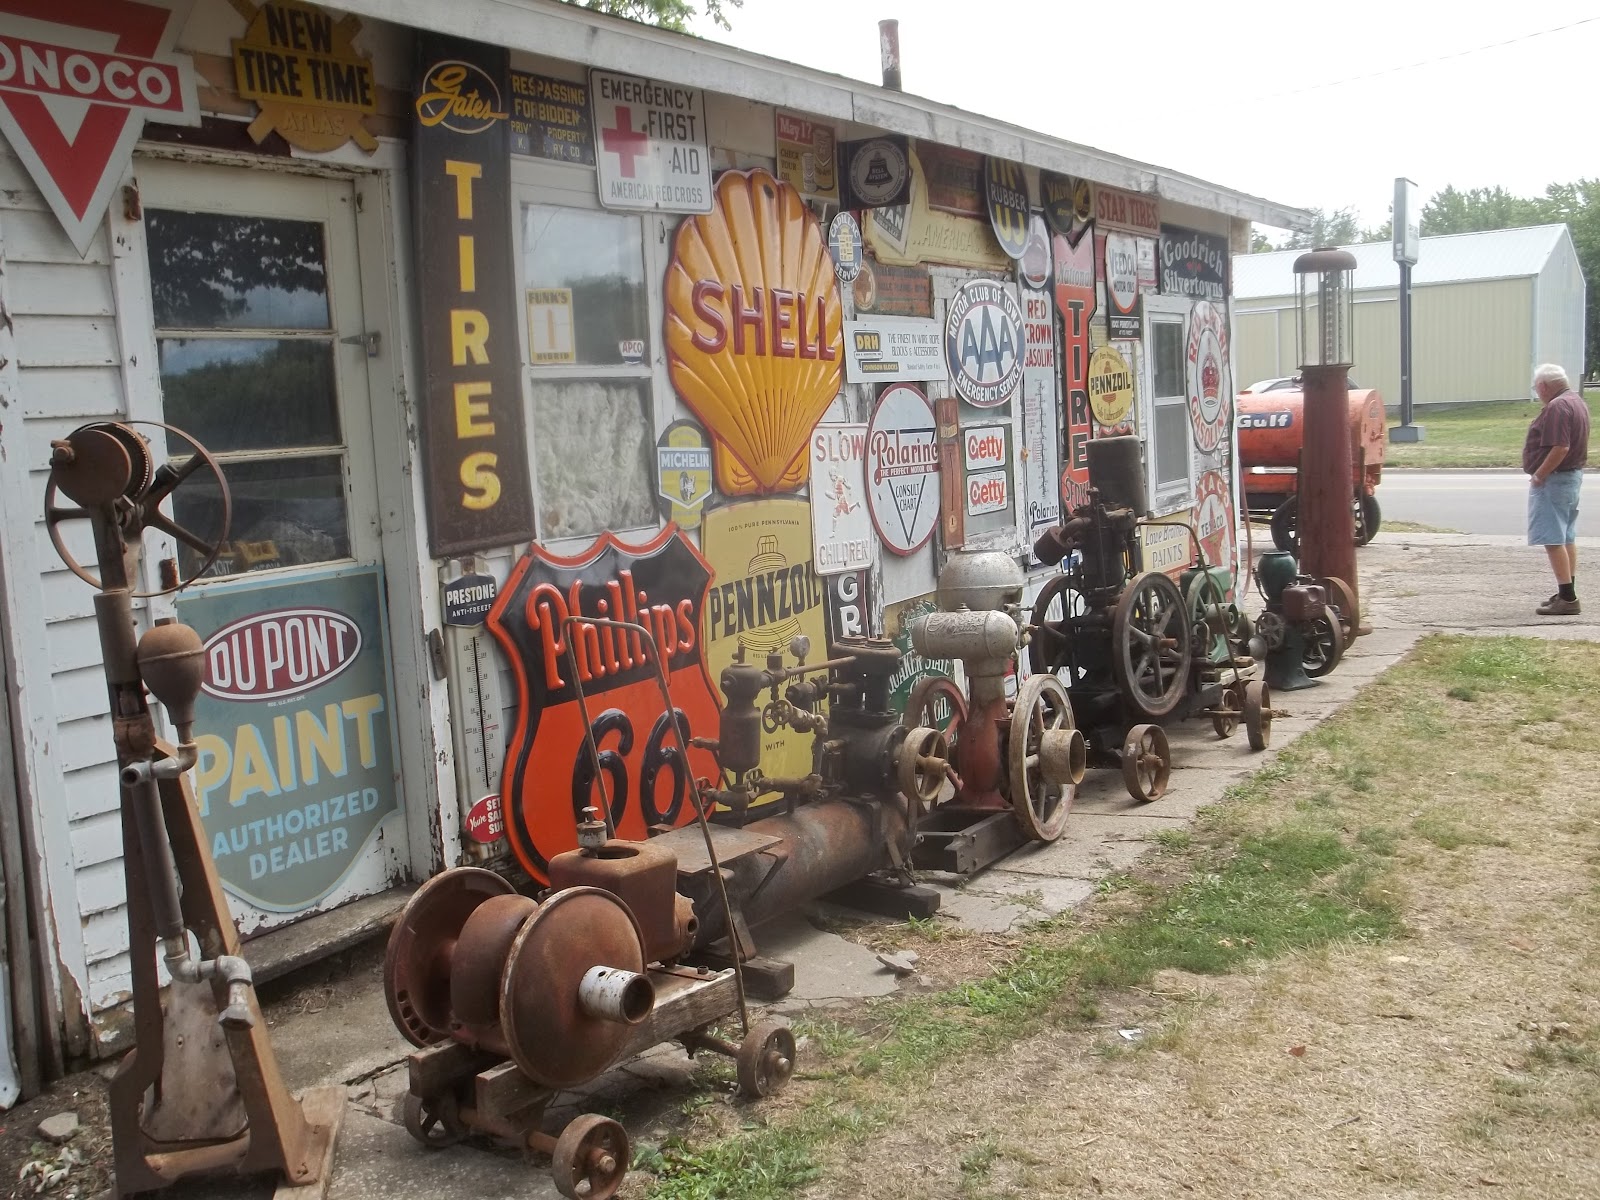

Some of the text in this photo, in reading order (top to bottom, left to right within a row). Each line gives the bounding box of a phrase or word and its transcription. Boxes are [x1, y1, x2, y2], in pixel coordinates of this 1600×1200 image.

[265, 3, 332, 54] NEW
[239, 48, 373, 106] TIRE TIME
[511, 74, 586, 106] RESPASSING
[415, 66, 509, 126] Gates
[601, 78, 694, 111] EMERGENCY
[283, 111, 346, 136] ATLAS
[514, 98, 580, 127] FORBIDDEN
[648, 111, 696, 143] FIRST
[672, 147, 700, 175] AID
[611, 181, 703, 204] AMERICAN RED CROSS
[990, 184, 1027, 213] RUBBER
[1097, 191, 1127, 223] STAR
[1130, 197, 1158, 231] TIRES
[830, 213, 860, 238] CADILLAC
[1109, 247, 1137, 278] VEEDOL
[1164, 235, 1223, 278] Goodrich
[834, 264, 860, 281] SERVICE
[1058, 261, 1093, 286] National
[1164, 268, 1224, 298] Silvertowns
[528, 292, 568, 305] FUNK'S
[950, 297, 969, 338] MOTOR
[970, 285, 988, 301] CLUB
[992, 288, 1001, 301] OF
[1004, 298, 1022, 331] IOWA
[1027, 300, 1047, 319] RED
[691, 279, 836, 361] SHELL
[445, 160, 503, 510] TIRES
[622, 341, 643, 354] APCO
[856, 335, 879, 350] DRH
[961, 305, 1016, 383] AAA
[956, 359, 1022, 402] EMERGENCY SERVICE
[1067, 300, 1089, 471] TIRE
[1090, 371, 1131, 397] PENNZOIL
[1190, 395, 1229, 449] GASOLINE
[1237, 414, 1290, 428] Gulf
[660, 452, 709, 468] MICHELIN
[815, 434, 865, 462] SLOW
[968, 434, 1004, 462] Getty
[880, 465, 934, 477] THE PERFECT MOTOR OIL
[896, 483, 920, 498] CONSULT
[900, 497, 918, 512] CHART
[970, 480, 1004, 506] Getty
[729, 519, 800, 533] 100% PURE PENNSYLVANIA
[1030, 501, 1058, 529] Polarine
[1201, 514, 1224, 538] TEXACO
[1145, 526, 1162, 547] Lowe
[819, 538, 869, 566] CHILDREN
[1152, 543, 1183, 569] PAINTS
[446, 583, 495, 607] PRESTONE
[709, 560, 821, 641] PENNZOIL
[525, 569, 696, 689] Phillips
[210, 617, 348, 691] DU PONT
[933, 696, 951, 722] OIL
[194, 693, 384, 818] PAINT
[765, 740, 785, 751] WITH
[572, 707, 692, 840] 66
[213, 787, 379, 859] AUTHORIZED
[249, 827, 349, 881] DEALER
